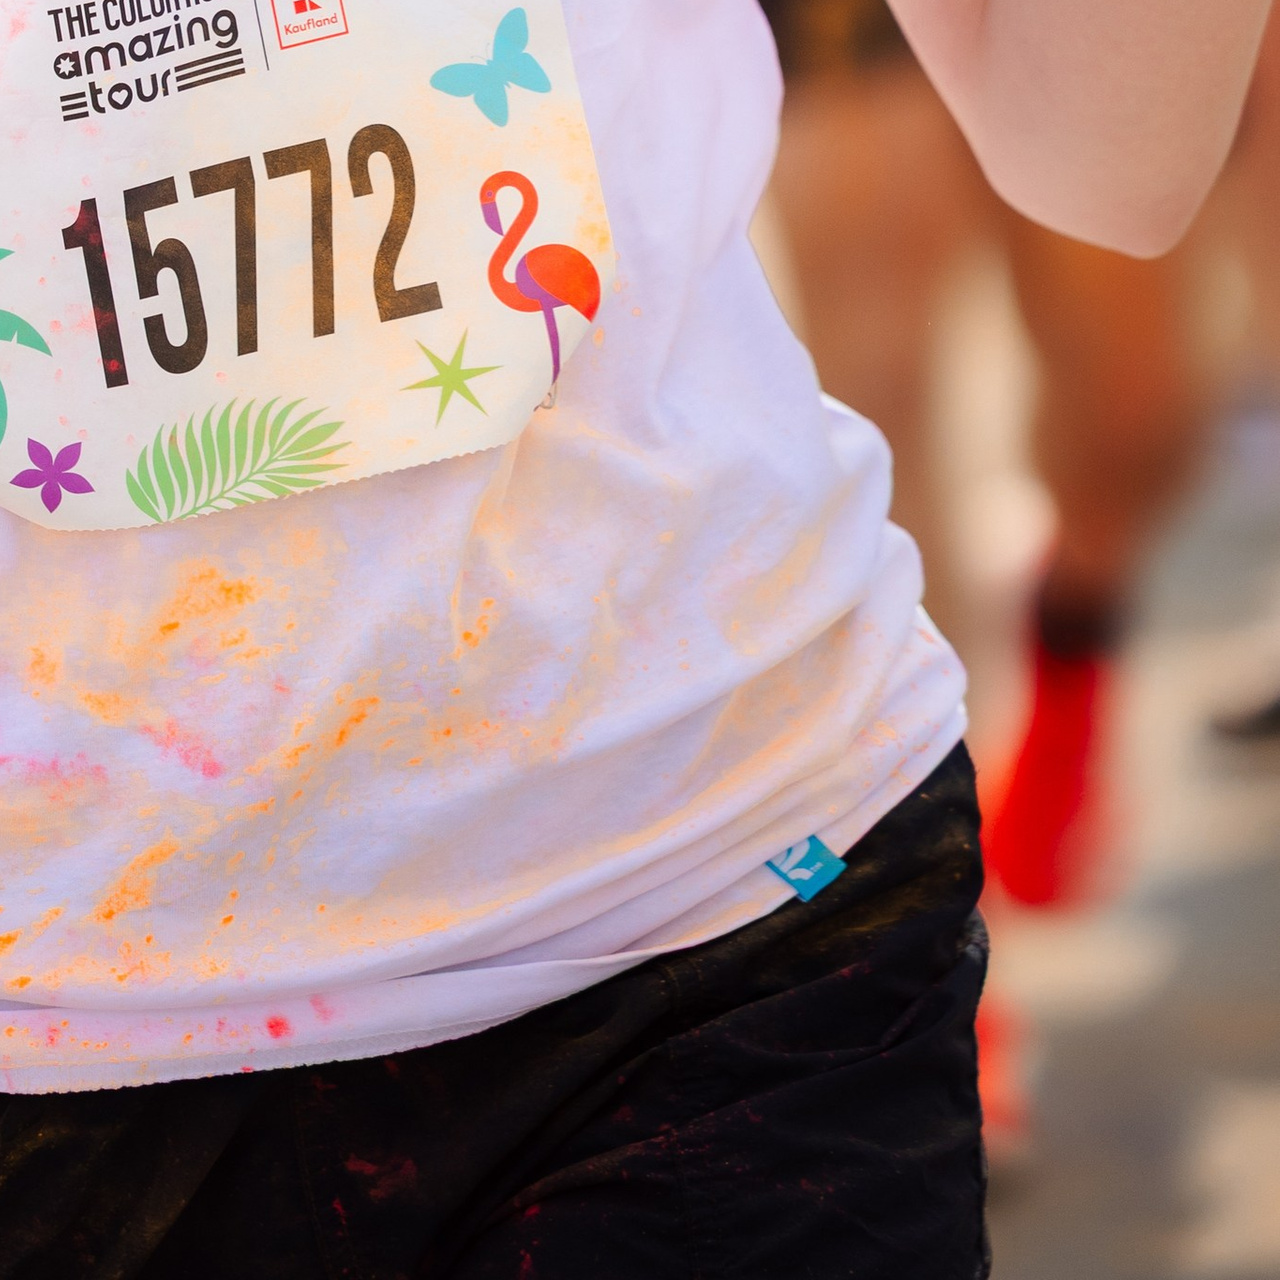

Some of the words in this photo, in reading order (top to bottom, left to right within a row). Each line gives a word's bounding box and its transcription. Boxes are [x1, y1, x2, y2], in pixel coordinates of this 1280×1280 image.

[47, 2, 100, 42] THE
[53, 9, 239, 80] amazing
[283, 13, 339, 36] Kaufland
[88, 68, 171, 114] tour
[61, 123, 444, 389] 15772
